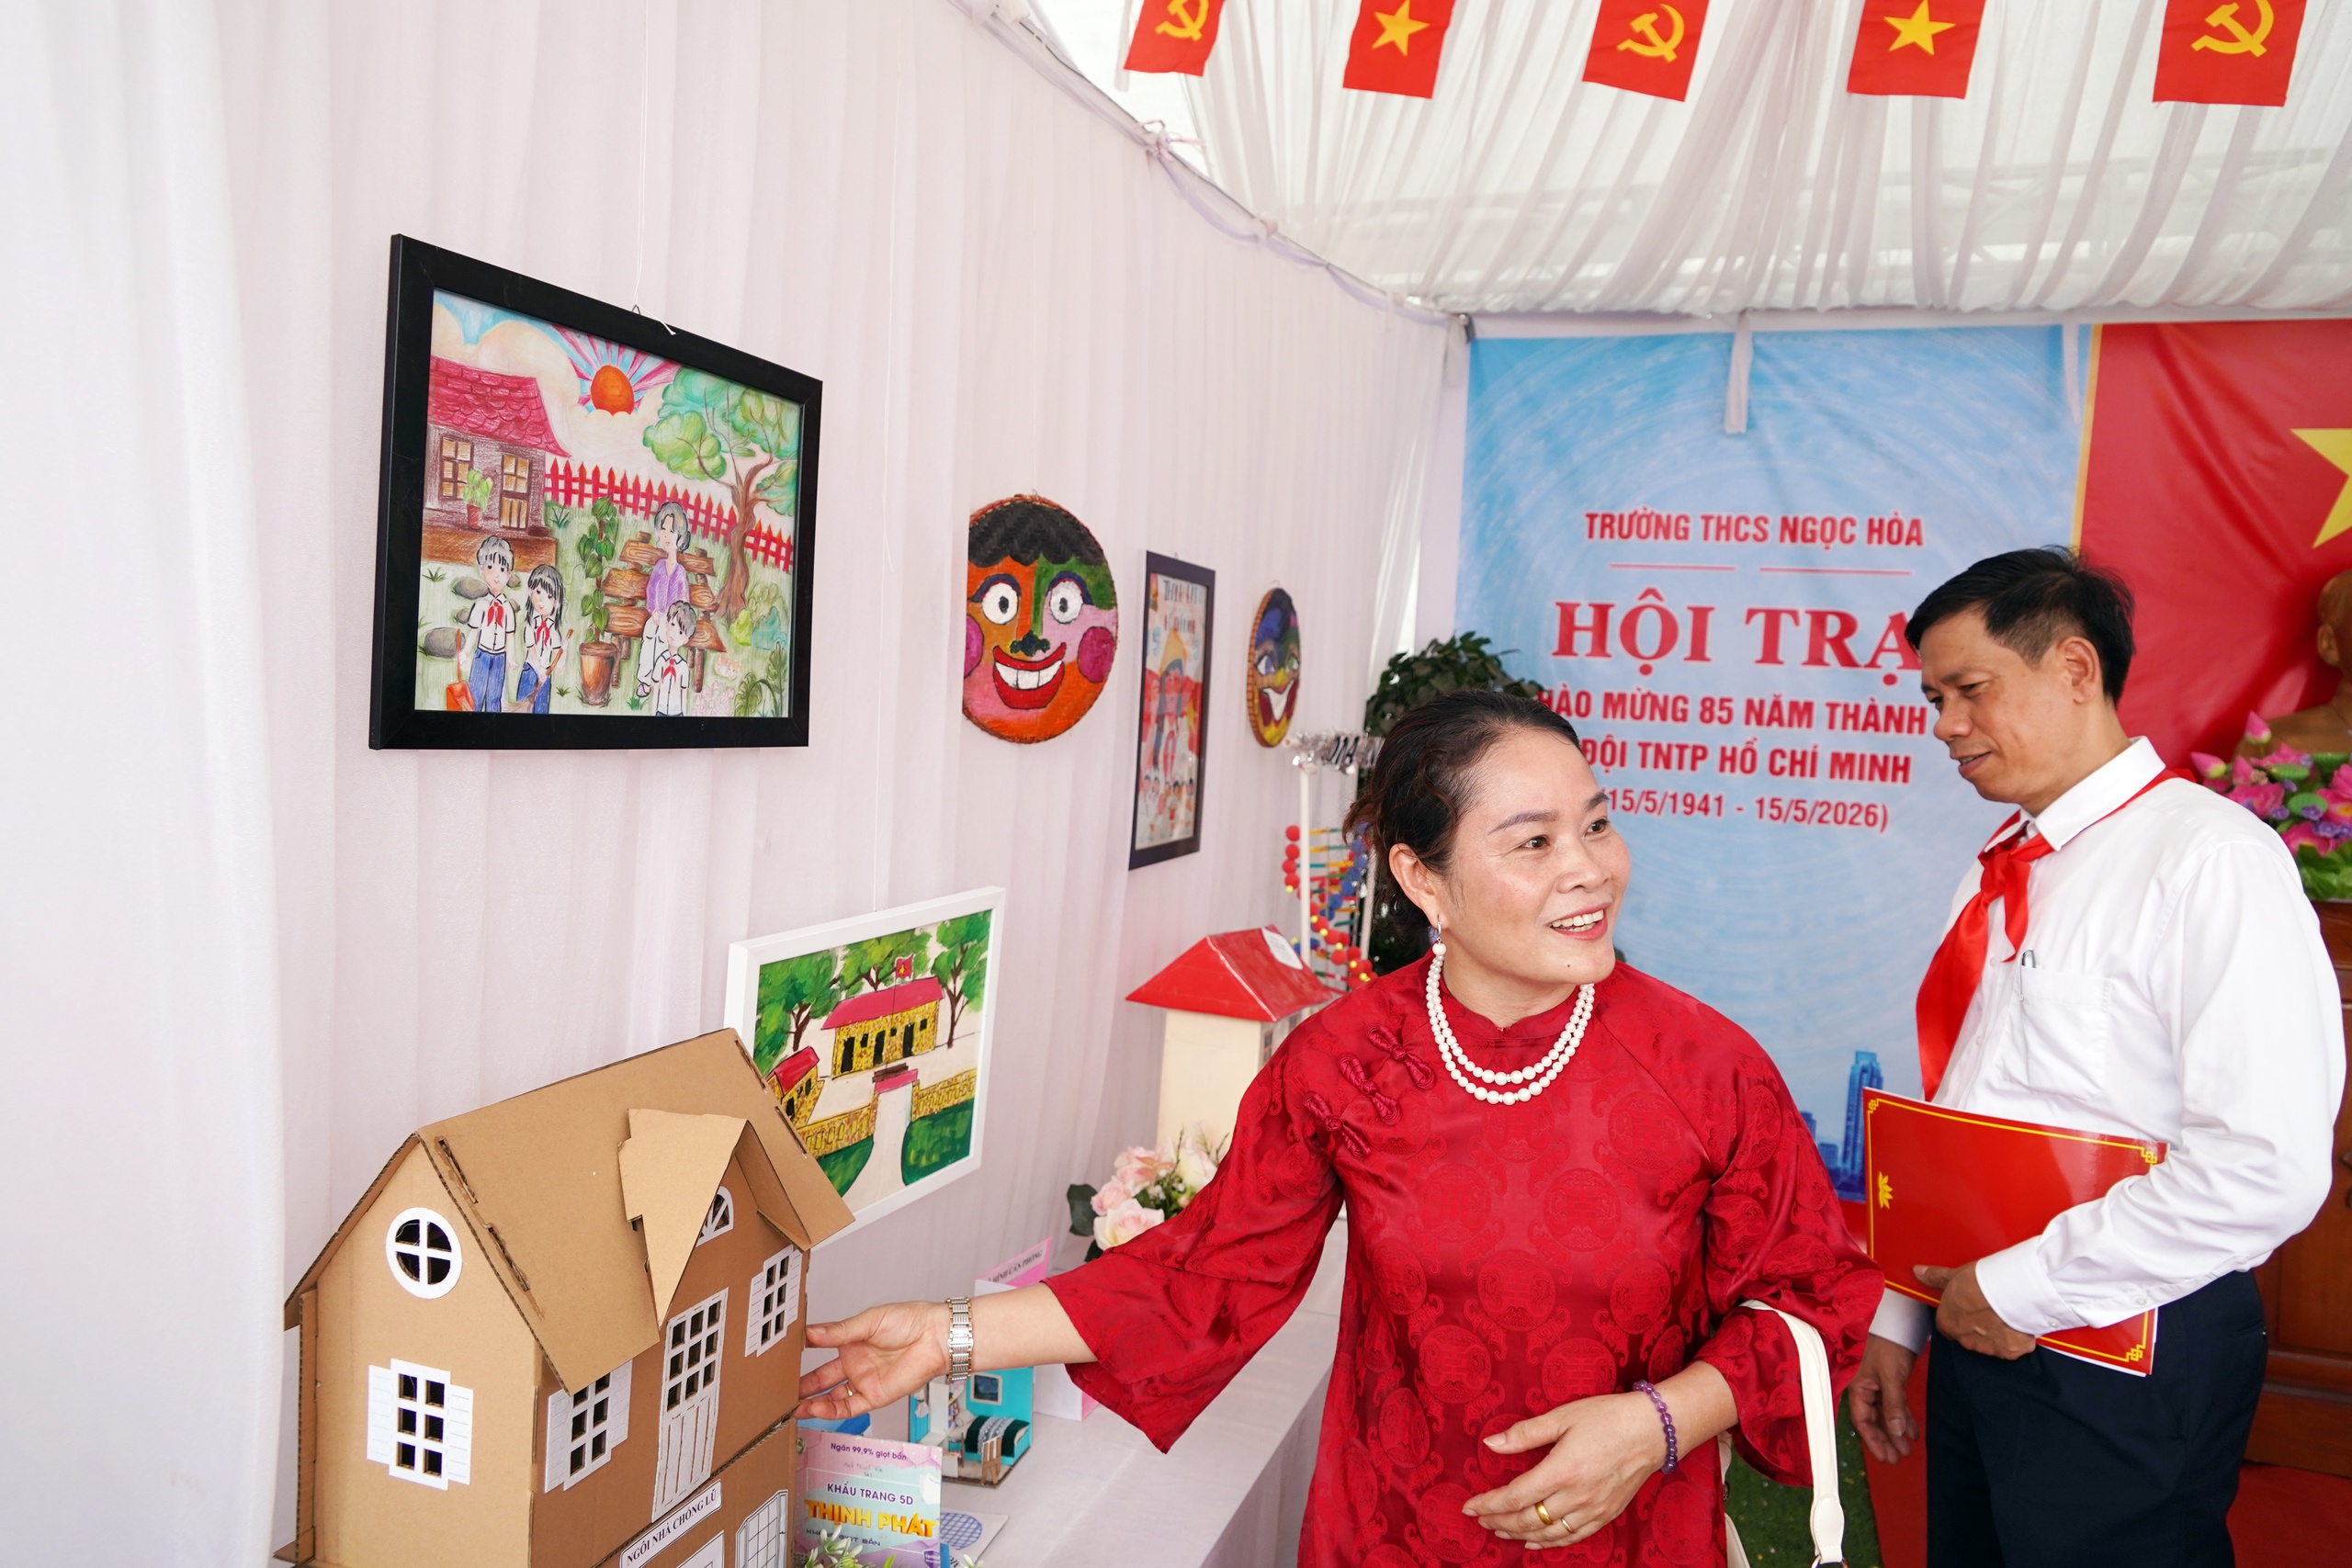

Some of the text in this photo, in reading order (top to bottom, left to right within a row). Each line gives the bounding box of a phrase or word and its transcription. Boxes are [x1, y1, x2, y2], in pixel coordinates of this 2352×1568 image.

[1585, 506, 1924, 551] TRƯỜNG THCS NGỌC HÒA
[1552, 587, 1923, 686] HỘI TRẠ
[1601, 686, 1690, 724] MỪNG
[1699, 695, 1735, 726] 85
[1744, 693, 1815, 729] NĂM
[1825, 696, 1928, 736] THÀNH
[1637, 741, 1709, 773] TNTP
[1718, 736, 1758, 775] HỒ
[1768, 744, 1819, 779] CHÍ
[1828, 750, 1913, 784] MINH
[1601, 787, 1724, 818] 15/5/1941
[1756, 796, 1889, 833] 15/5/2026)
[852, 1446, 874, 1456] 99,9%
[827, 1481, 914, 1506] KHẨU TRANG 5D
[804, 1499, 938, 1539] THỊNH PHÁT
[627, 1540, 650, 1566] NGÔI
[651, 1522, 672, 1546] NHÀ
